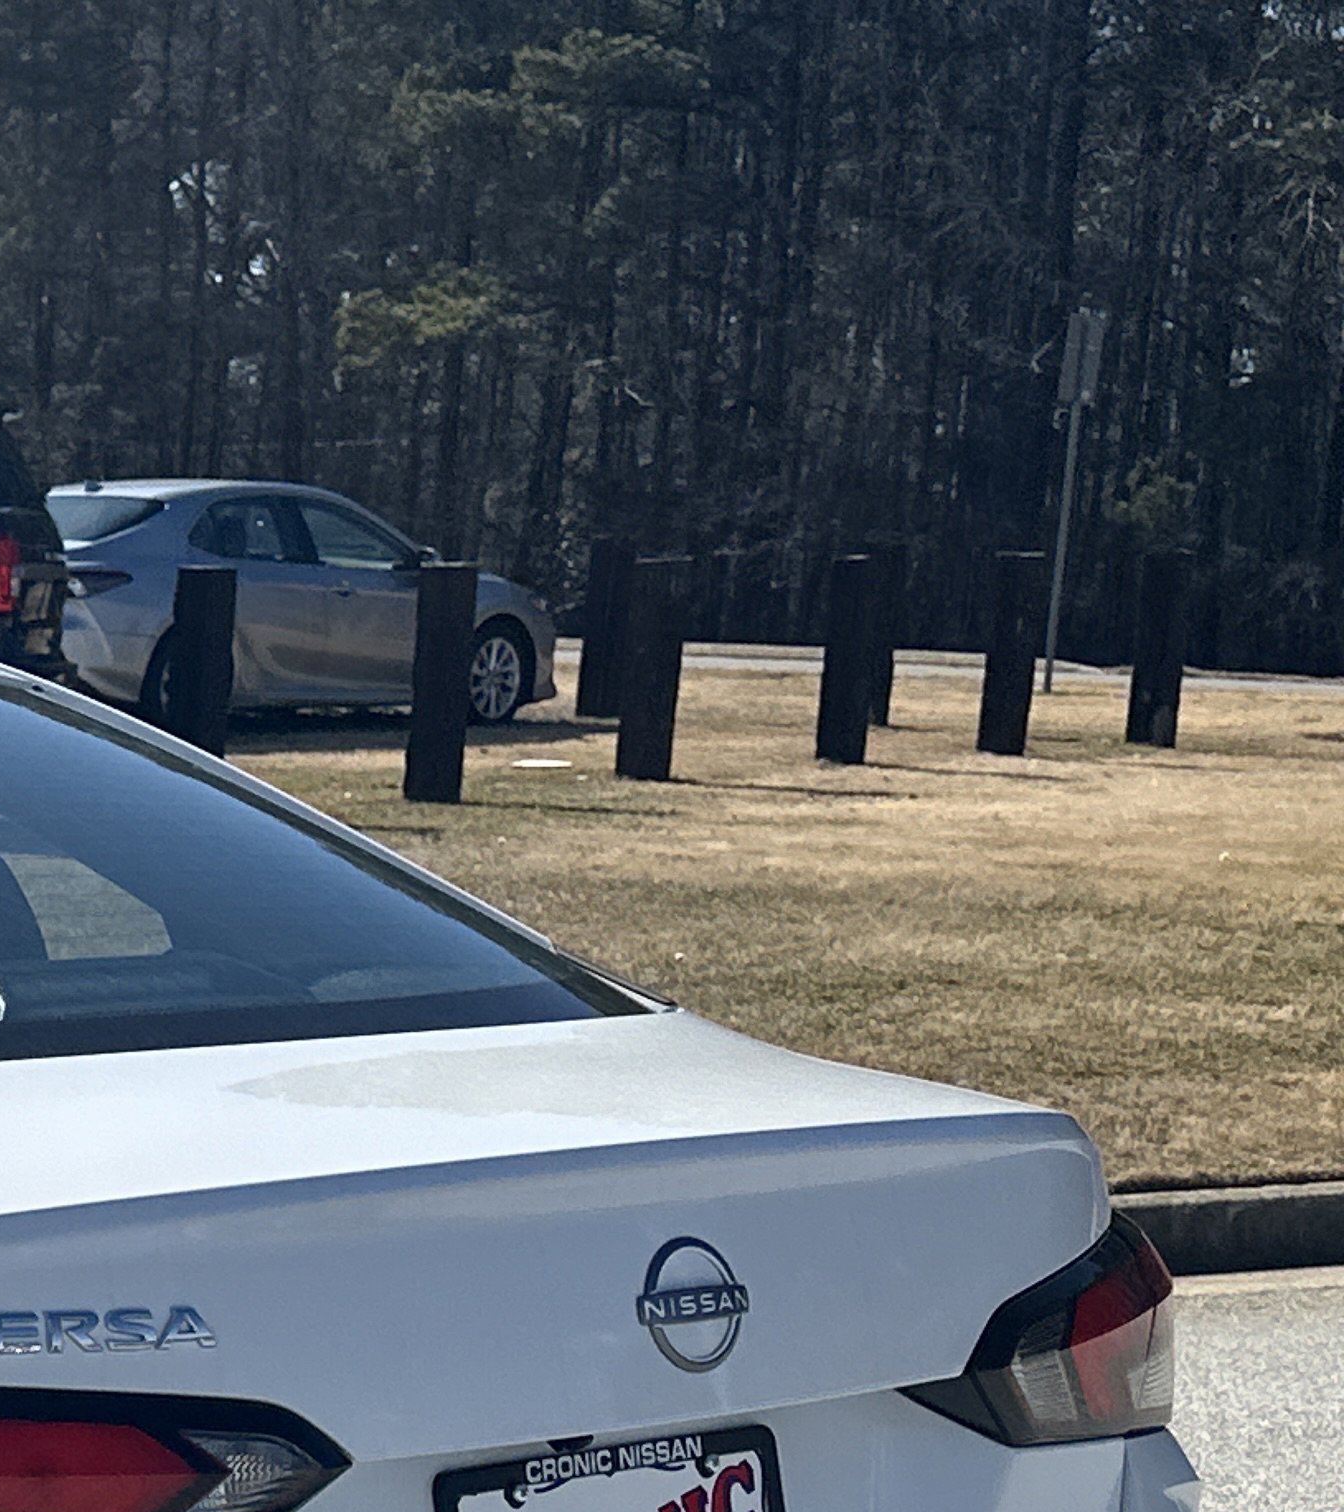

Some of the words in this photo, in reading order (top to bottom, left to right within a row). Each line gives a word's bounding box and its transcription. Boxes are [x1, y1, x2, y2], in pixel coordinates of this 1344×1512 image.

[642, 1288, 748, 1321] NISSAN
[525, 1449, 612, 1484] CRONIC
[618, 1435, 704, 1470] NISSAN
